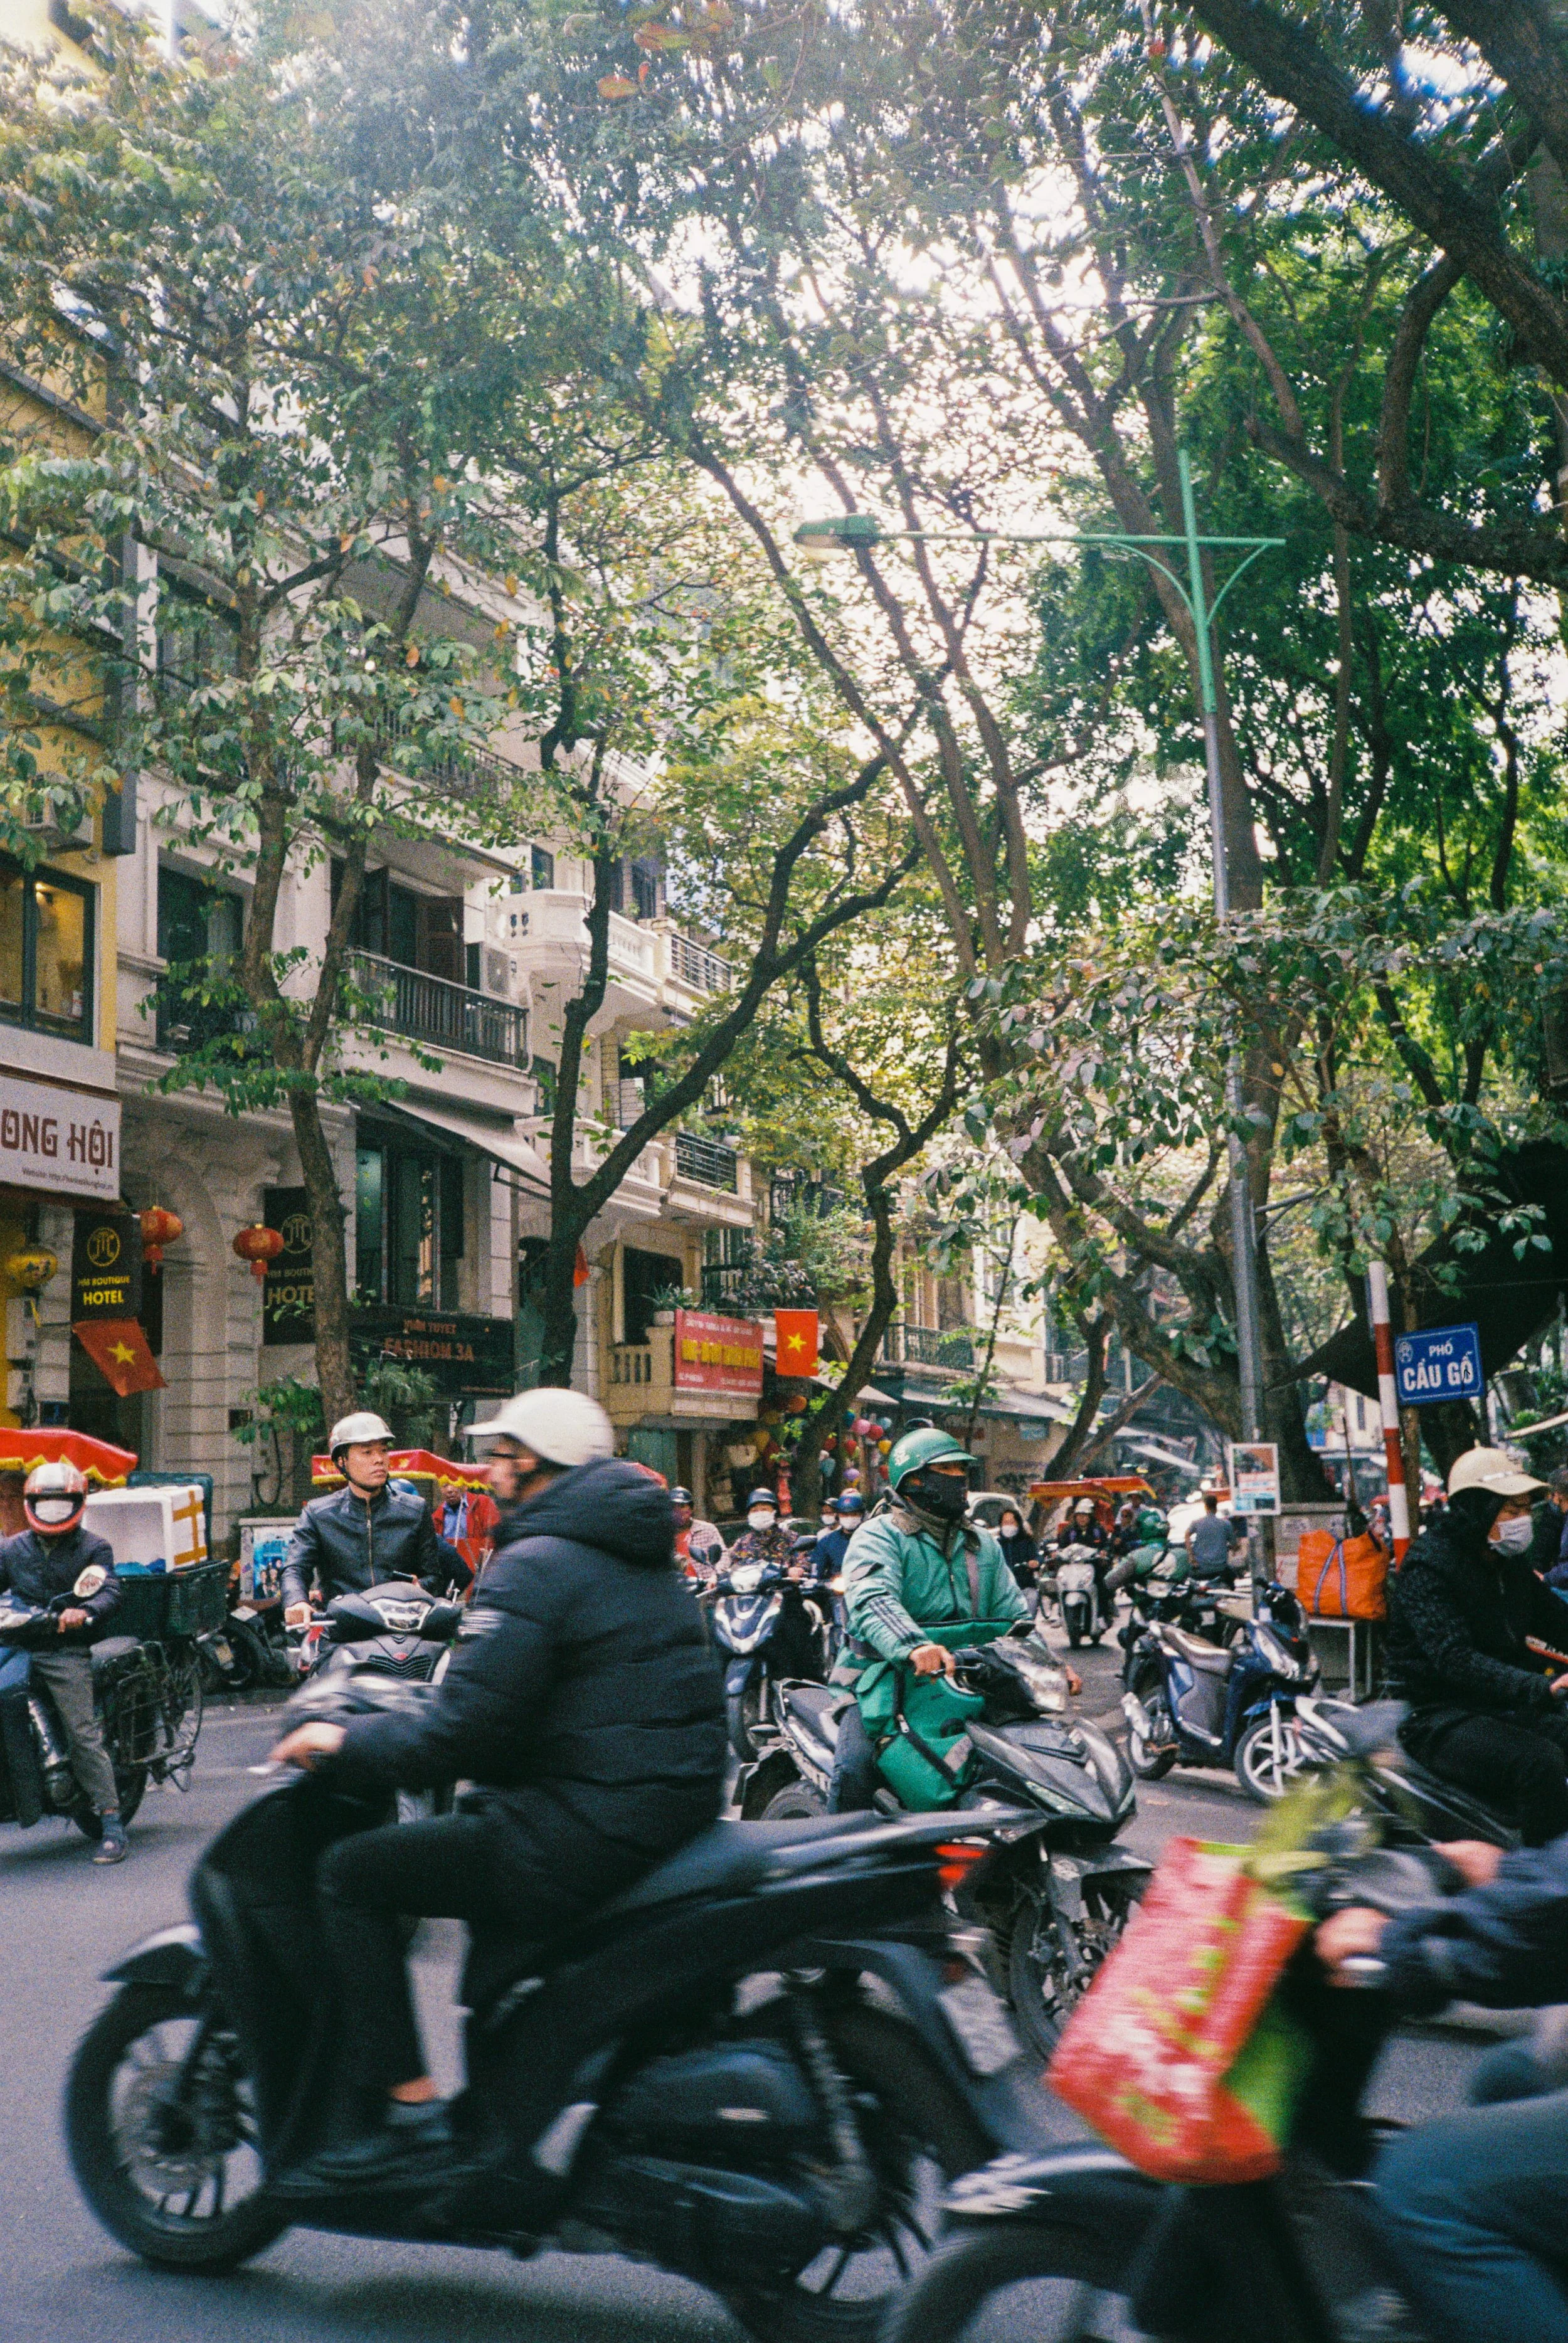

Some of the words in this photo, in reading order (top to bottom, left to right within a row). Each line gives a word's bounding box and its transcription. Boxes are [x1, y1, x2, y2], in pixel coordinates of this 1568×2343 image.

[1, 1109, 58, 1158] ONG
[66, 1119, 113, 1175] HỘI
[92, 1275, 130, 1286] BOUTIQUE
[83, 1289, 124, 1305] HOTEL
[1429, 1338, 1453, 1357] PHỐ
